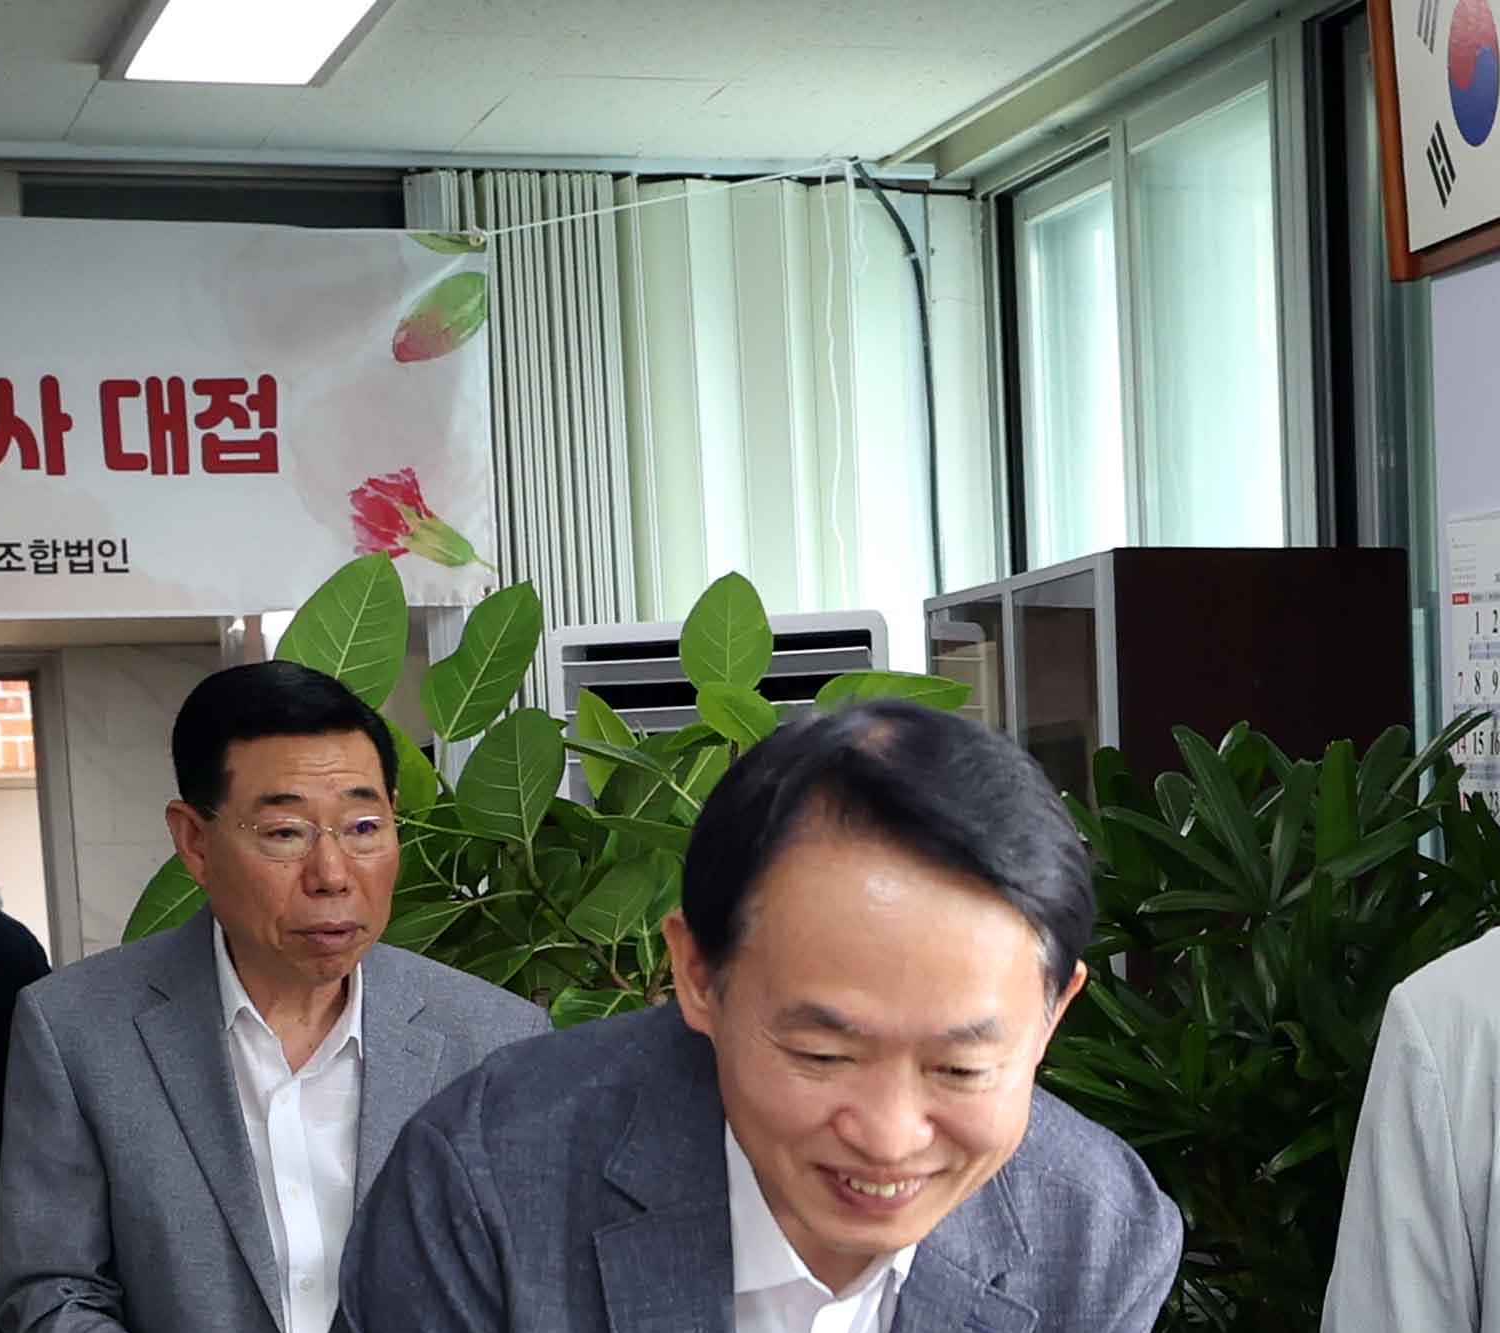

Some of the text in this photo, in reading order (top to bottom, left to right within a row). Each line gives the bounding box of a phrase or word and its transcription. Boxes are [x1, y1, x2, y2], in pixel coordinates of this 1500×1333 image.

[98, 375, 280, 476] 대접
[1474, 670, 1481, 695] 8
[1492, 669, 1499, 694] 9
